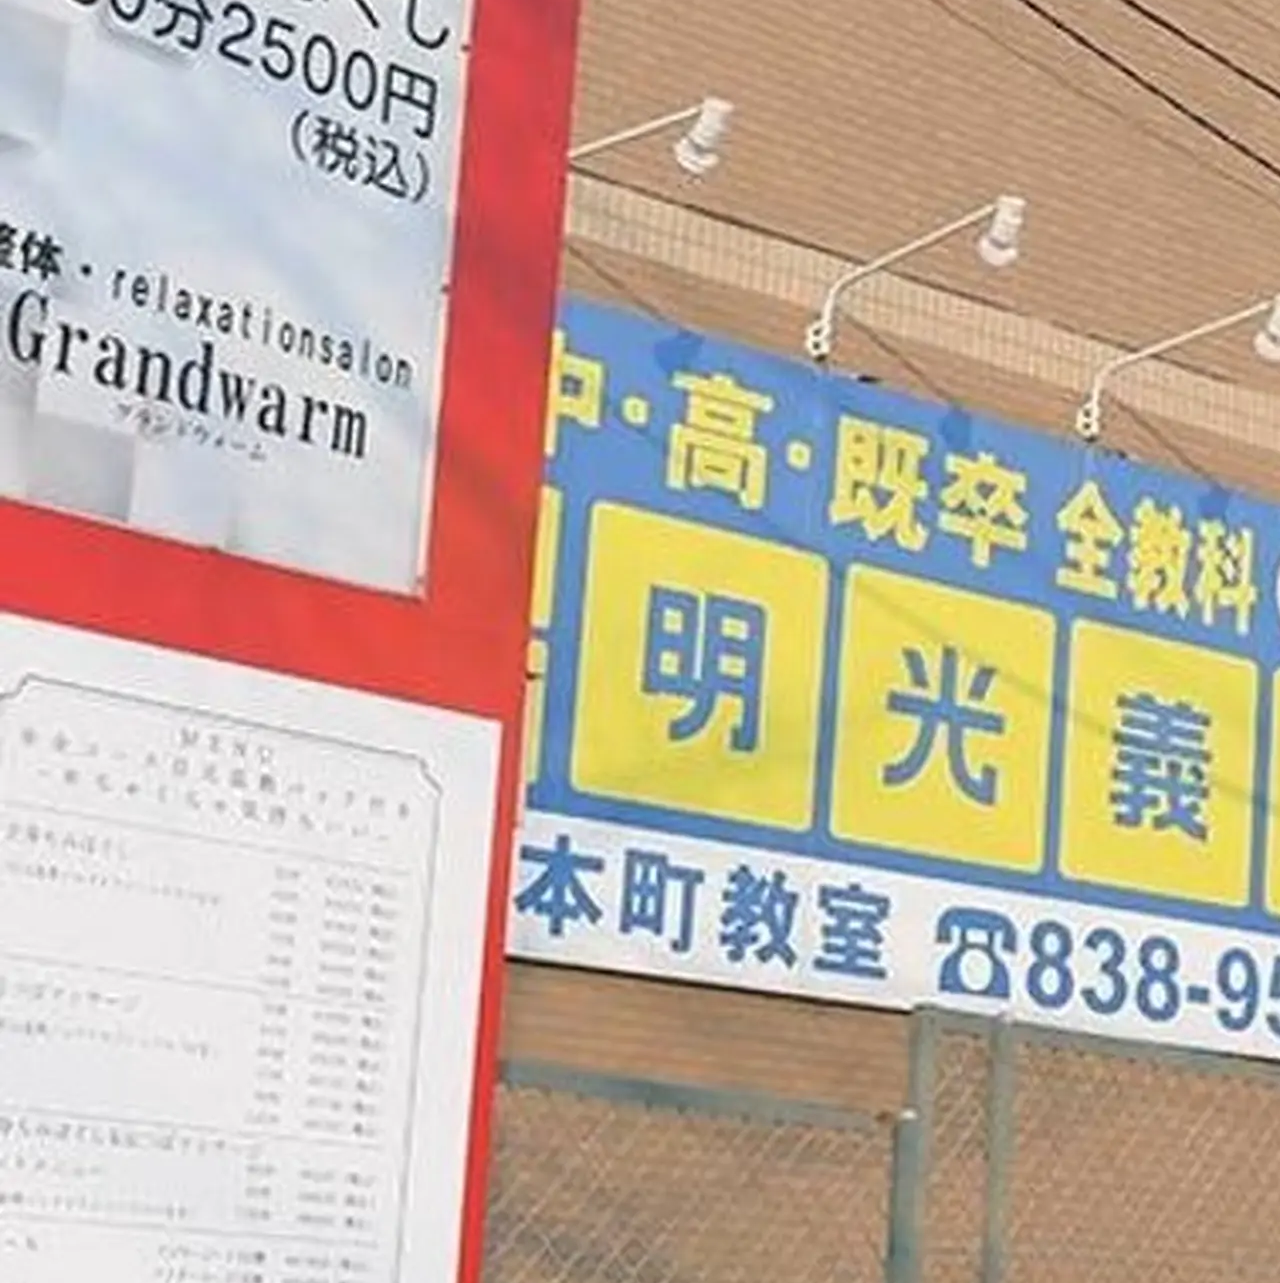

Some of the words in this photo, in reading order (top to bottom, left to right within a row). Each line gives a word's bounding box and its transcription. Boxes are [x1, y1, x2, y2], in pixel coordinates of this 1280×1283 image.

[292, 109, 430, 204] (税込)
[8, 288, 369, 458] Grandwarm
[1055, 479, 1258, 636] 全教科
[514, 831, 891, 983] 本町教室
